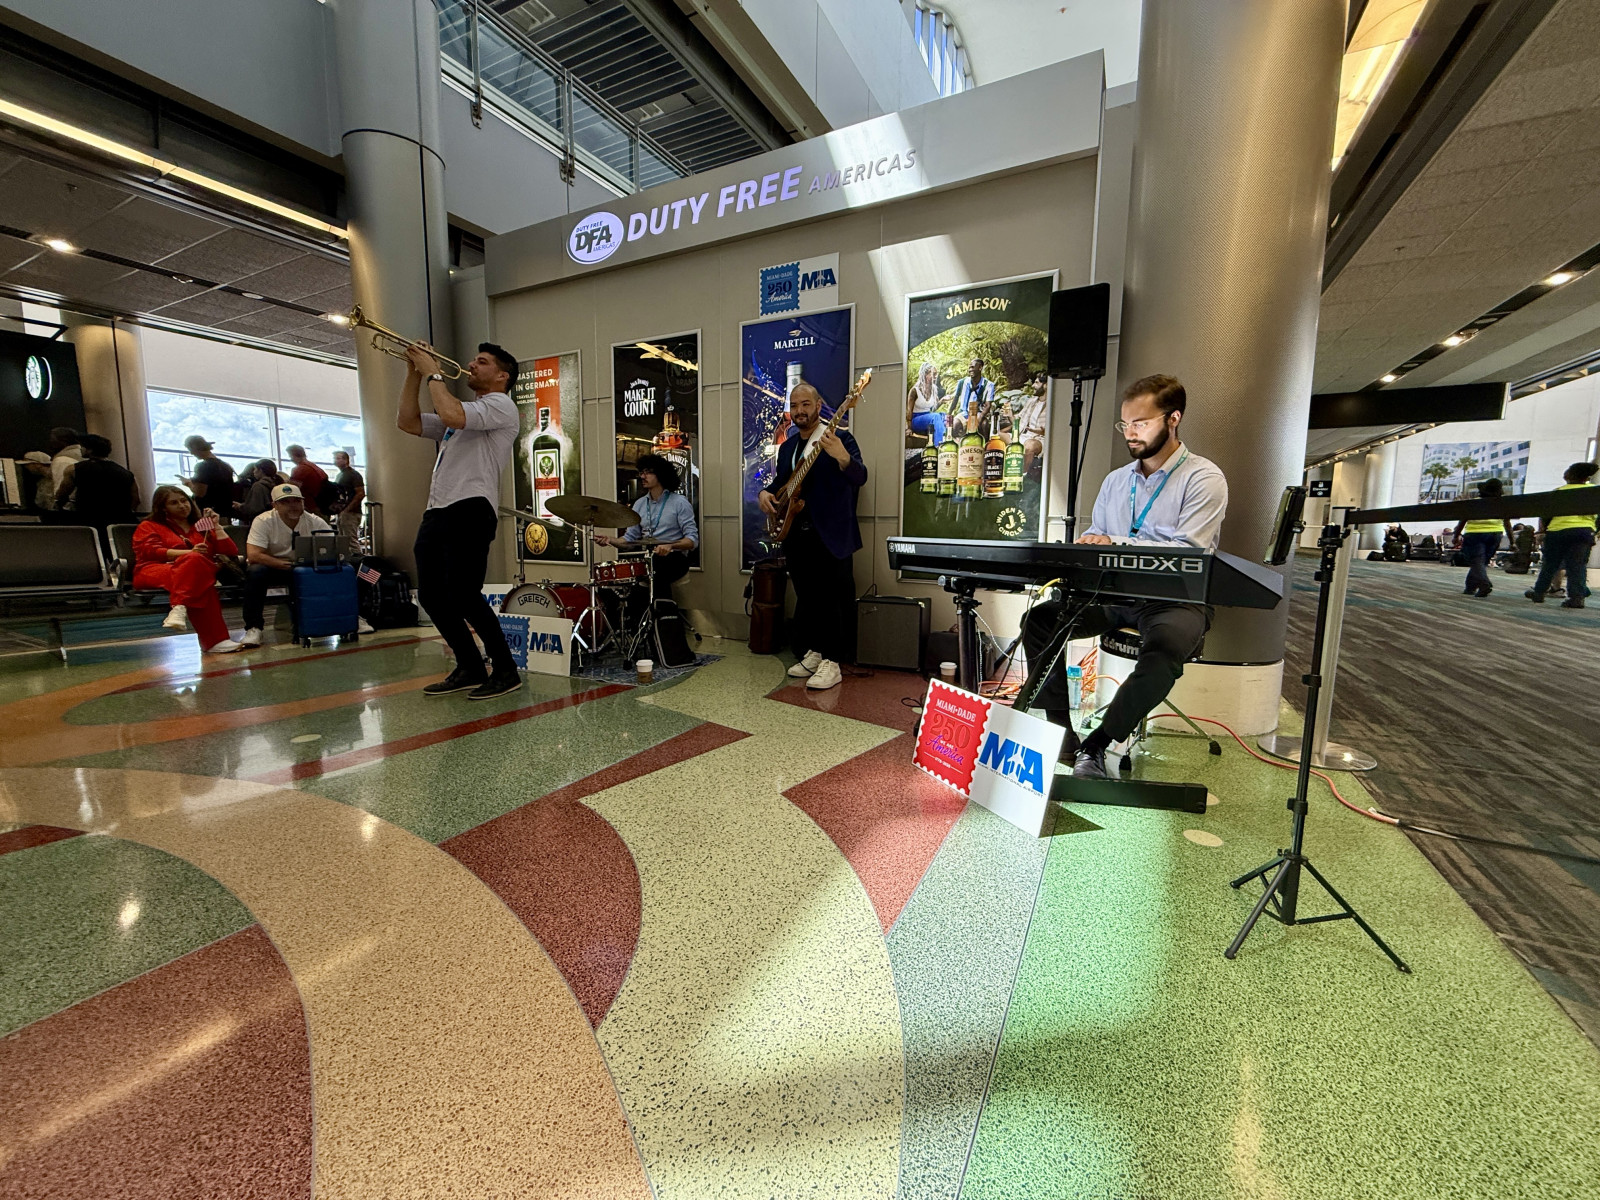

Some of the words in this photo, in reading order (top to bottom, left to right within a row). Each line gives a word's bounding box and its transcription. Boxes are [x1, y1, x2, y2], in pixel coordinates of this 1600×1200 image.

[627, 193, 710, 242] DUTY
[717, 165, 803, 218] FREE
[808, 149, 917, 194] AMERICAS
[576, 224, 590, 232] DUTY
[590, 220, 604, 229] FREE
[575, 224, 613, 254] DFA
[800, 267, 837, 291] MIA
[767, 280, 793, 296] 250
[946, 297, 1010, 320] JAMESON
[773, 336, 816, 350] MARTELL
[515, 384, 523, 392] IN
[524, 378, 560, 390] GERMANY
[624, 388, 645, 402] MAKE
[647, 387, 656, 400] IT
[624, 399, 656, 417] COUNT
[984, 451, 1004, 459] JAMESON
[996, 507, 1016, 524] WIDEN
[1016, 509, 1027, 524] THE
[1005, 514, 1017, 529] J
[998, 526, 1024, 537] CIRCLE
[894, 542, 916, 554] YAMAHA
[517, 593, 551, 609] GRETSCH
[504, 633, 522, 648] 50
[529, 631, 564, 654] MIA
[1103, 636, 1140, 656] ddrum
[930, 713, 971, 749] 250
[925, 734, 964, 766] America
[978, 731, 1044, 794] MIA
